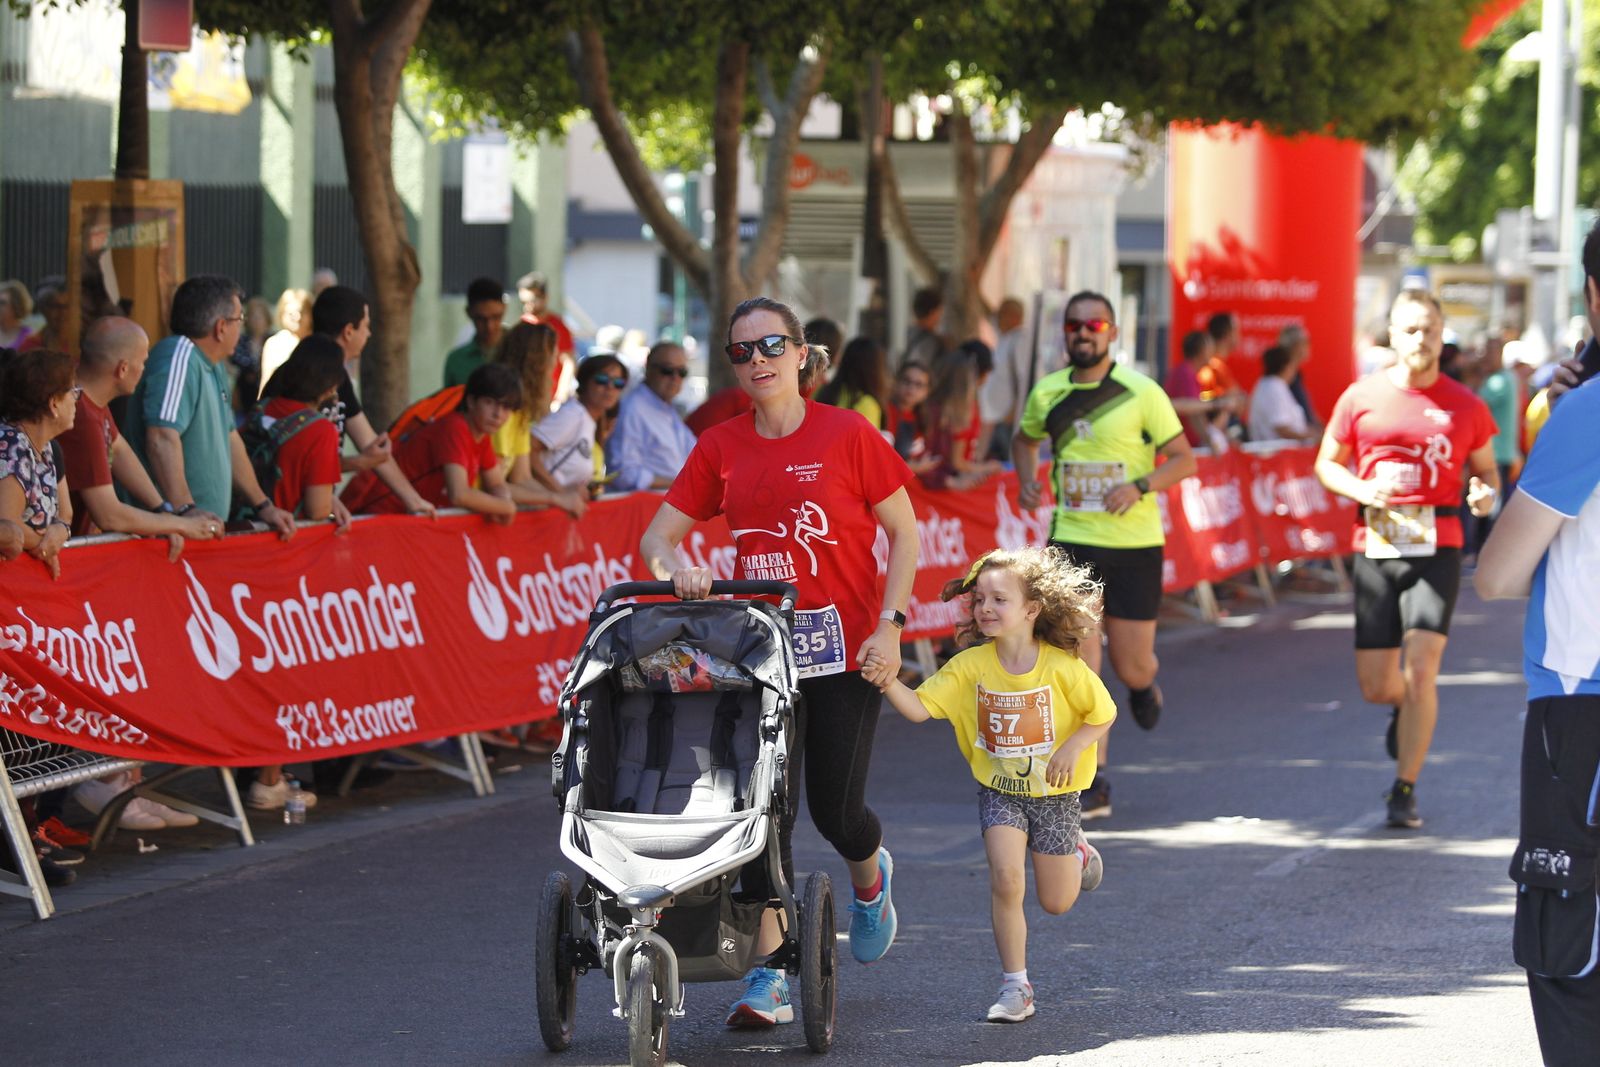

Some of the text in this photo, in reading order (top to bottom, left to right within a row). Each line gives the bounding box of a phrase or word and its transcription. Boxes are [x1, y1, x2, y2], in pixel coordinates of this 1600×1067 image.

[794, 462, 823, 471] Santander
[741, 551, 794, 570] CARRERA
[744, 565, 797, 581] SOLIDARIA
[231, 565, 425, 673] Santander
[989, 712, 1020, 735] 57
[995, 735, 1024, 745] VALERIA
[991, 774, 1031, 792] CARRERA
